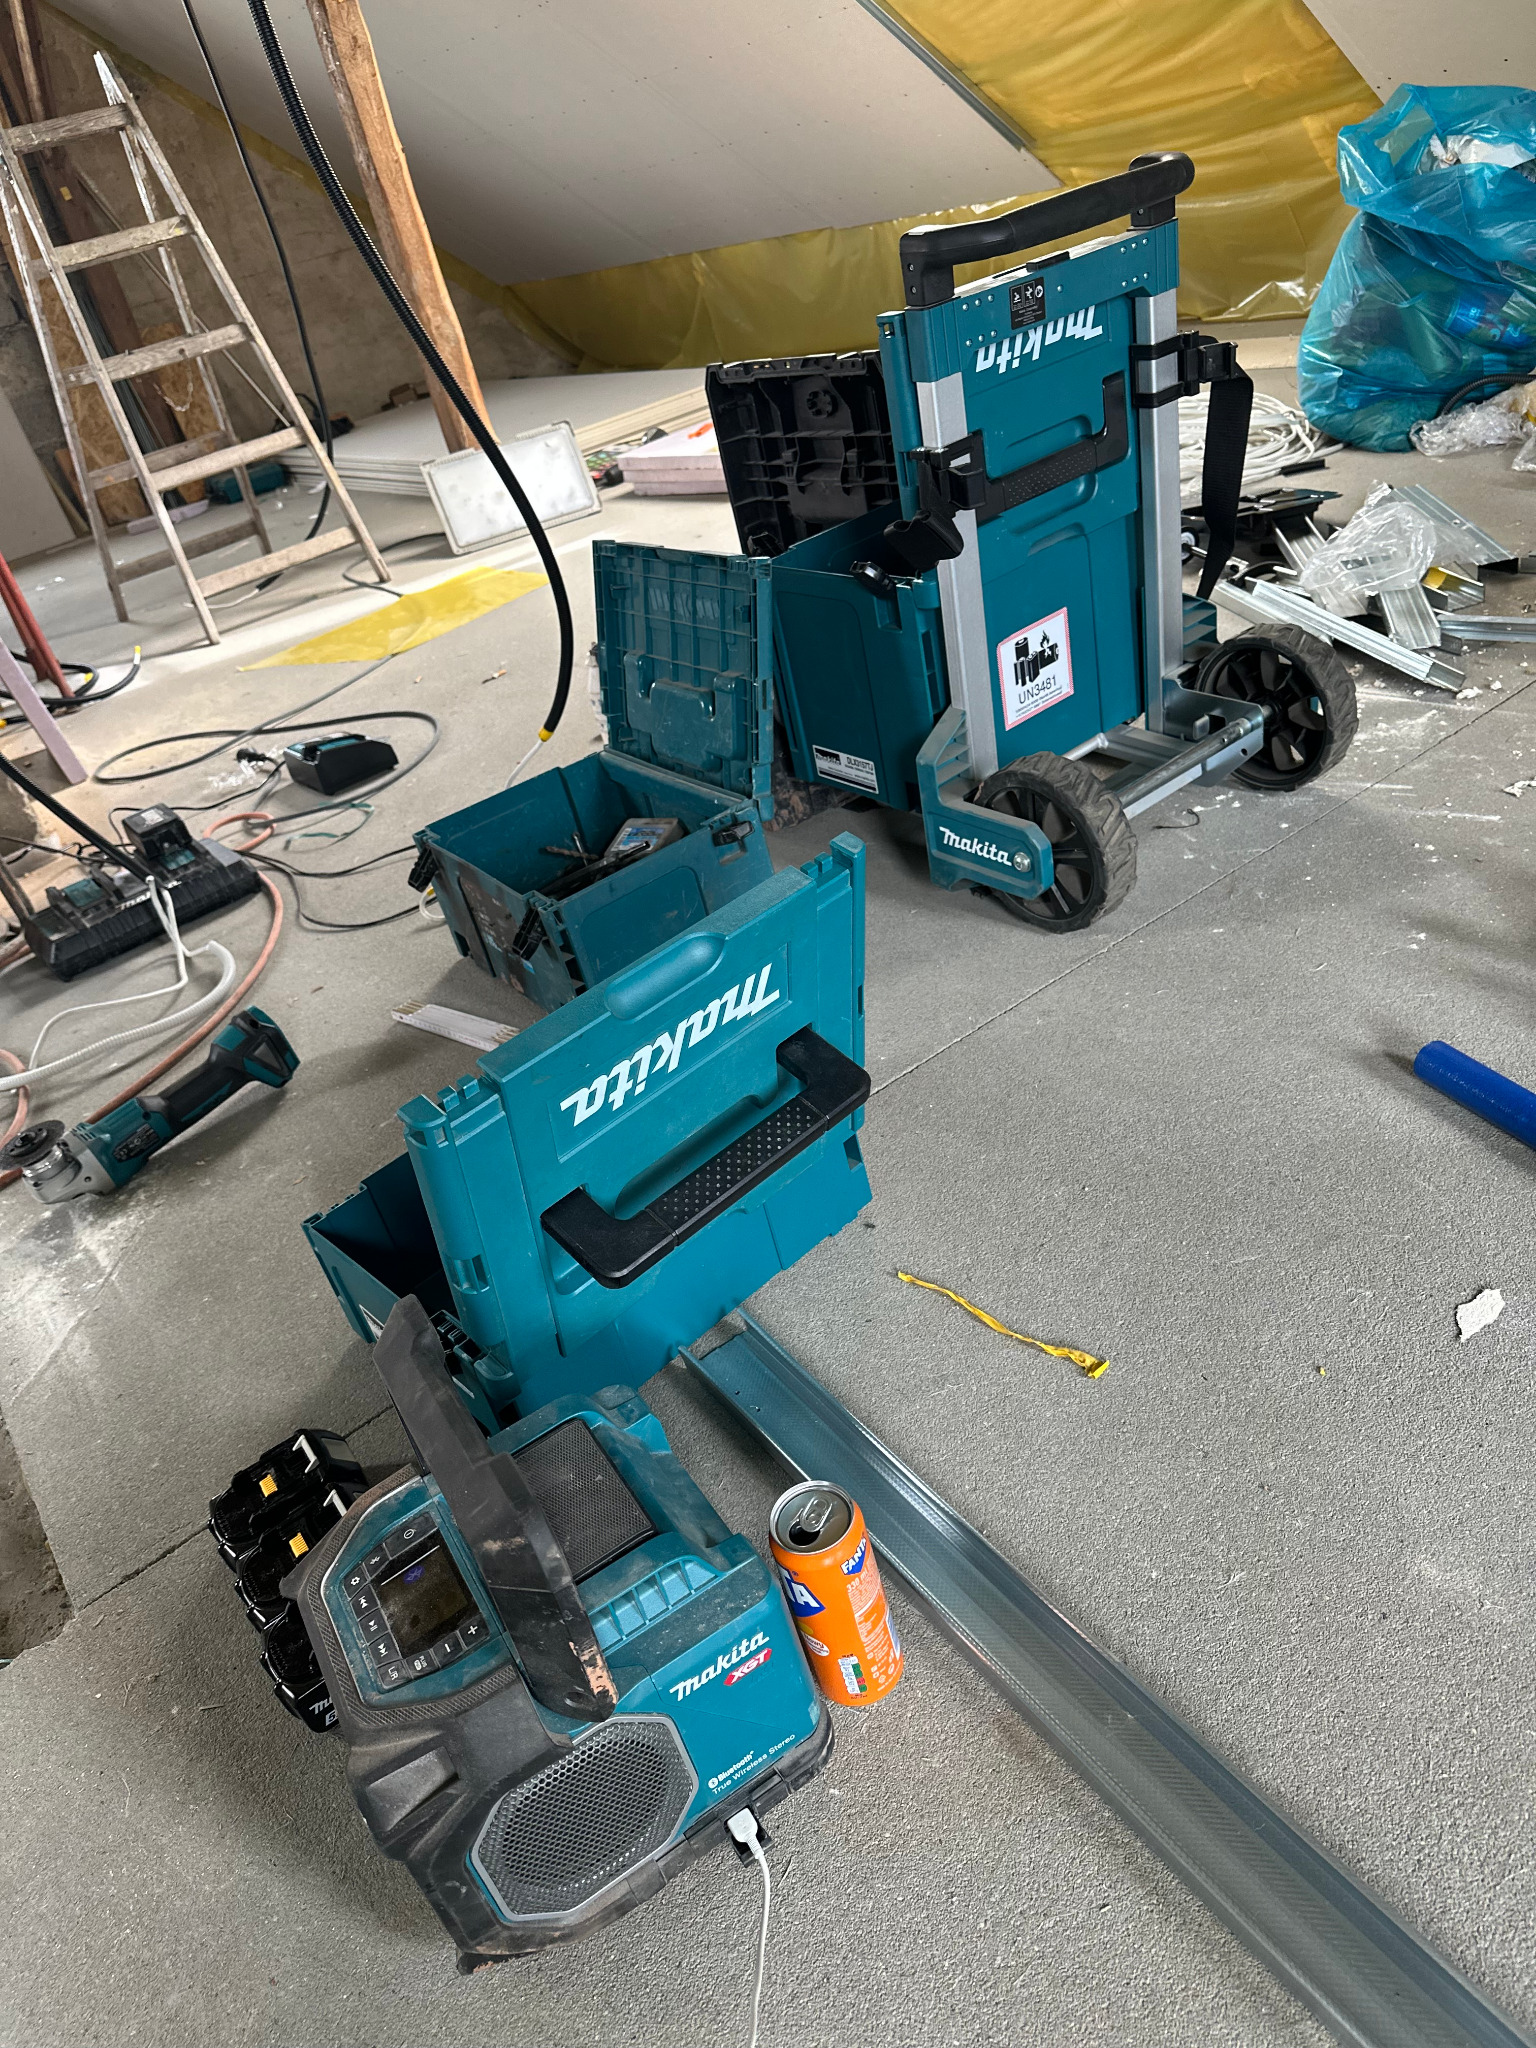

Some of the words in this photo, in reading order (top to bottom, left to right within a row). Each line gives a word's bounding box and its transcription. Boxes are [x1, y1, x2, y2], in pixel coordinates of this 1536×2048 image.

[975, 304, 1103, 374] makita
[1018, 674, 1057, 704] UN3481
[939, 826, 1012, 867] makita
[560, 963, 780, 1127] makita
[846, 1578, 860, 1593] 330
[669, 1631, 770, 1702] makita
[731, 1649, 768, 1684] XGT
[712, 1780, 732, 1795] True
[732, 1753, 768, 1780] Wireless
[768, 1734, 796, 1755] Stereo
